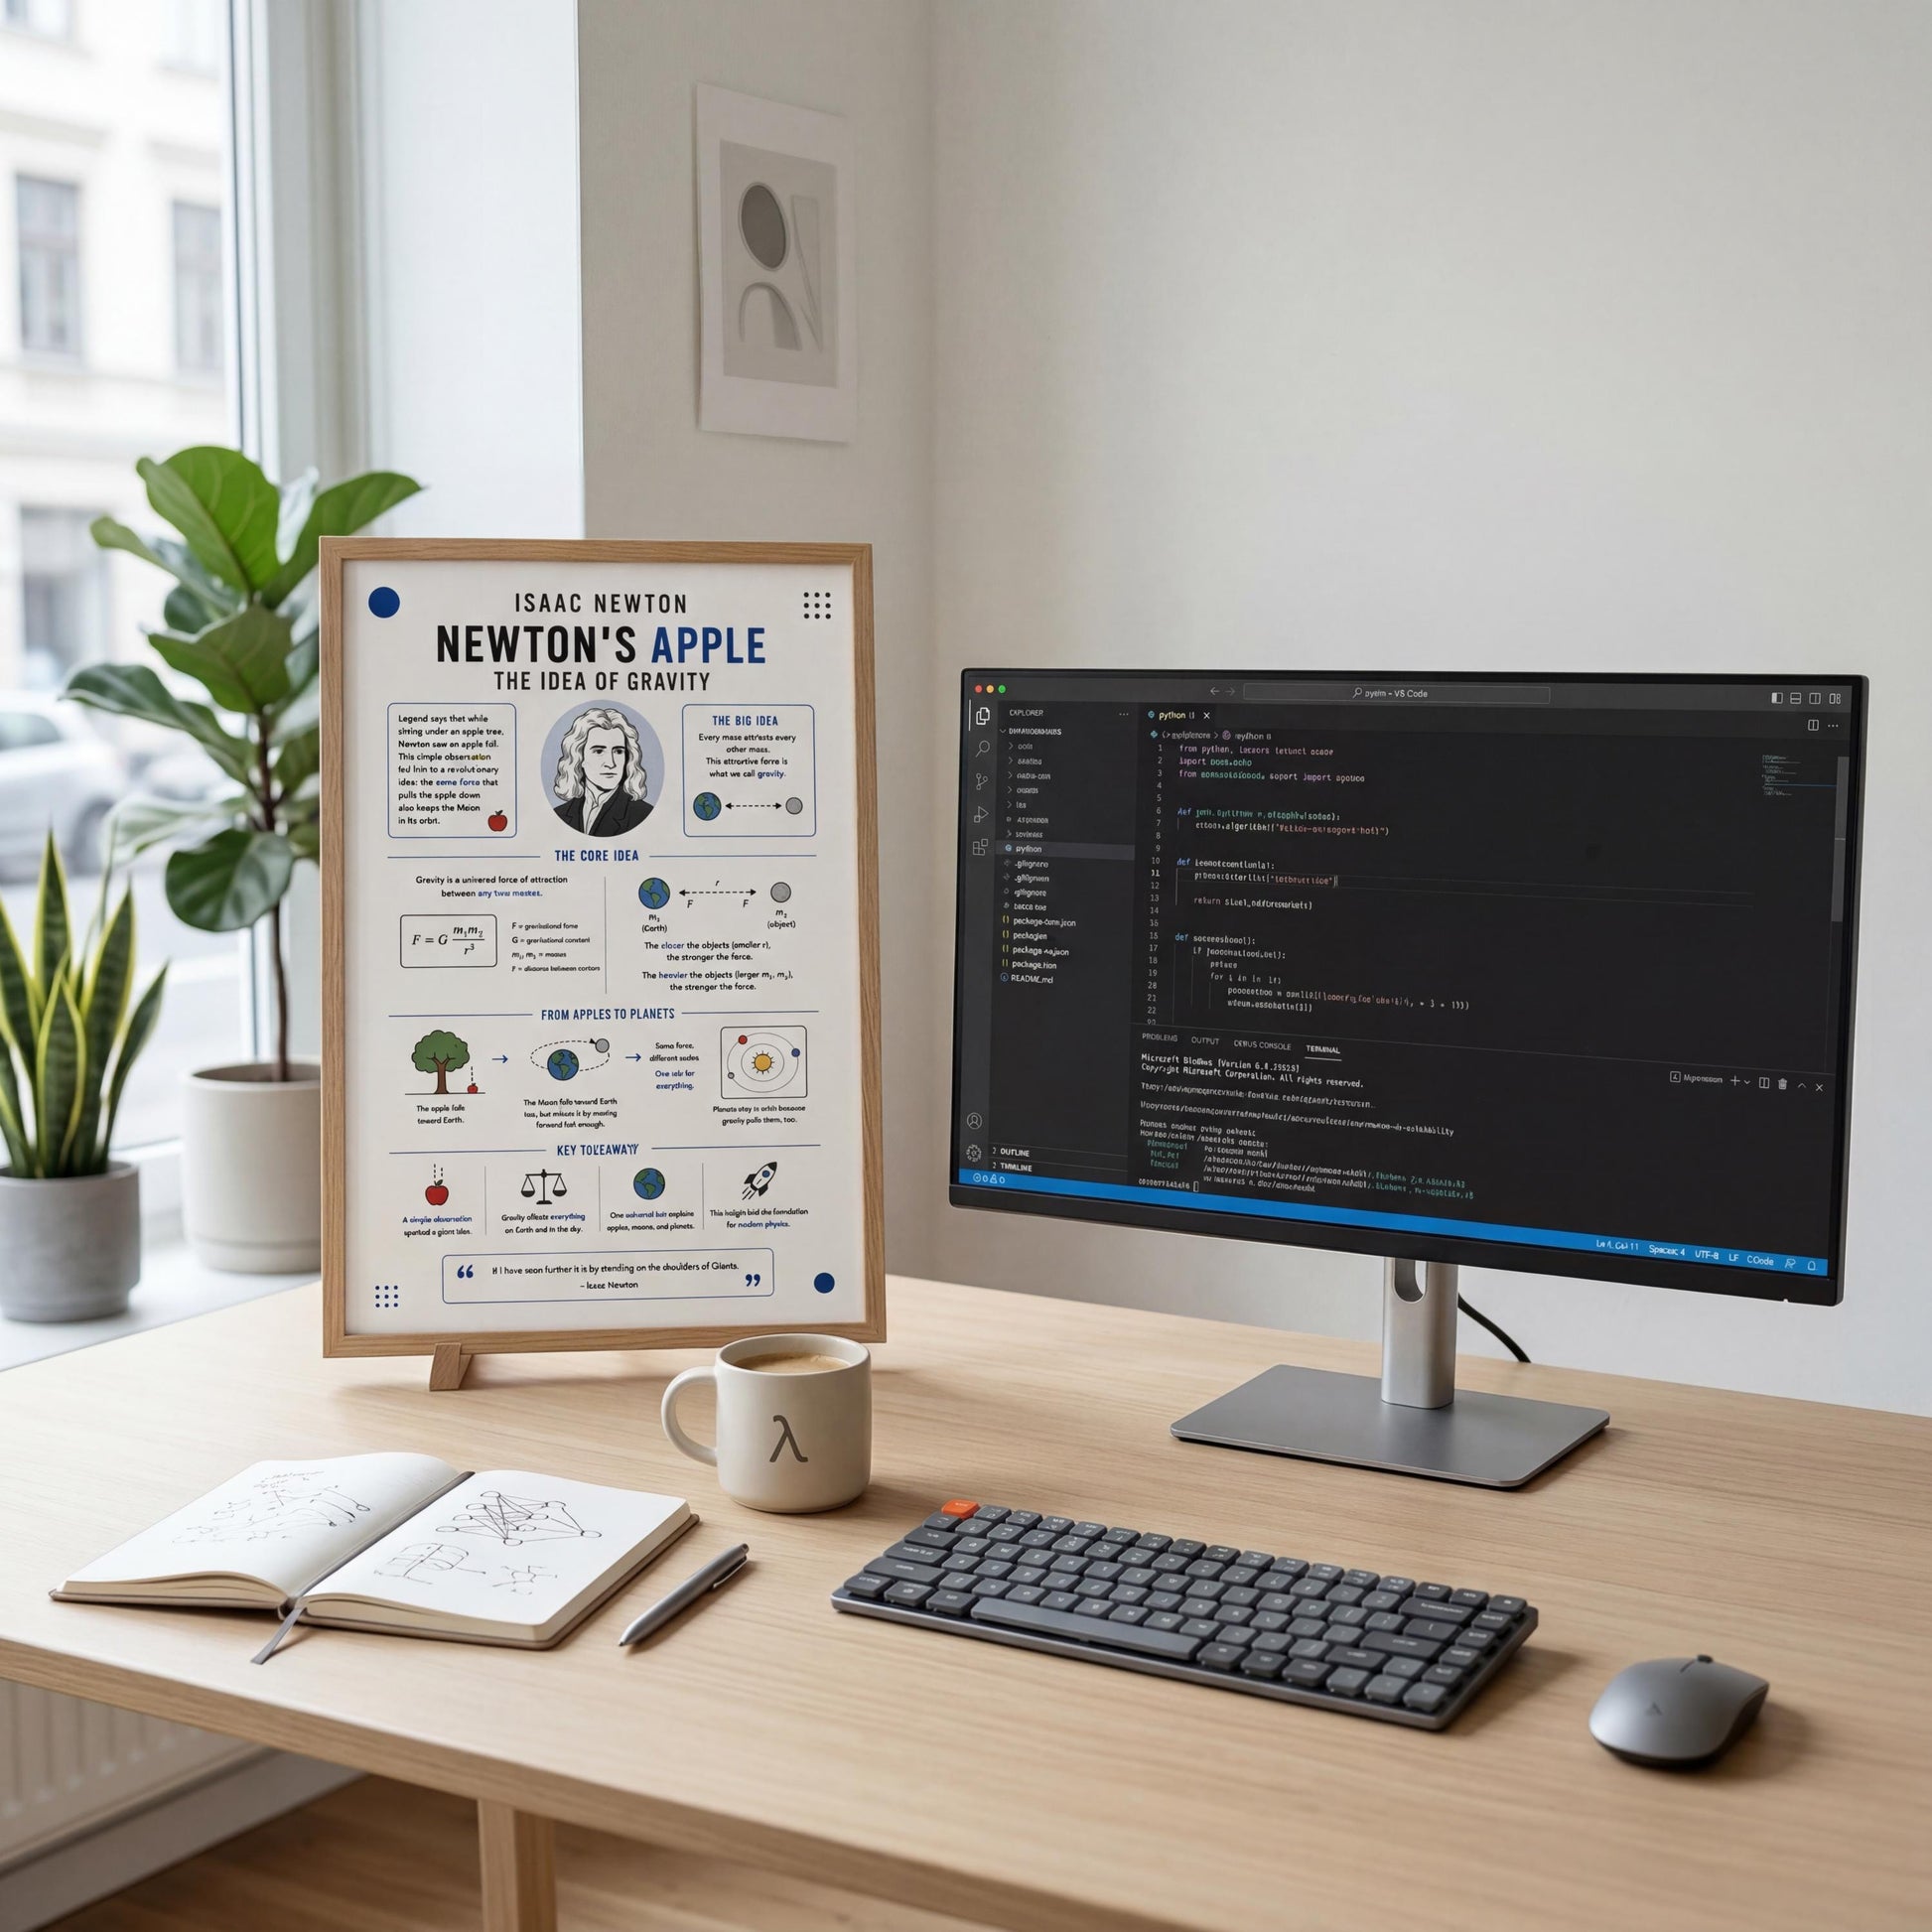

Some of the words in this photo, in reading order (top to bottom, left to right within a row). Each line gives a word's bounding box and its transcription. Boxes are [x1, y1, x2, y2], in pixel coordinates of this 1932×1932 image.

[515, 593, 582, 614] ISAAC
[595, 594, 686, 614] NEWTON
[437, 624, 636, 663] NEWTON'S
[651, 626, 765, 664] APPLE
[493, 671, 531, 691] THE
[541, 671, 586, 691] IDEA
[596, 671, 620, 691] OF
[627, 671, 710, 691] GRAVITY
[398, 715, 428, 725] Legend
[468, 714, 488, 723] while
[712, 715, 731, 726] THE
[735, 715, 752, 726] BIG
[757, 715, 778, 726] IDEA
[699, 733, 720, 744] Every
[774, 735, 796, 744] every
[398, 790, 417, 801] pulls
[419, 790, 433, 799] the
[554, 850, 576, 862] THE
[580, 850, 609, 862] CORE
[614, 850, 639, 862] IDEA
[681, 954, 715, 963] stronger
[542, 1009, 569, 1021] FROM
[573, 1009, 612, 1020] APPLES
[614, 1009, 626, 1020] TO
[630, 1008, 675, 1020] PLANETS
[582, 1110, 592, 1119] by
[557, 1145, 576, 1156] KEY
[544, 1265, 572, 1274] further
[589, 1265, 600, 1275] by
[701, 1261, 710, 1271] of
[769, 1415, 808, 1462] λ
